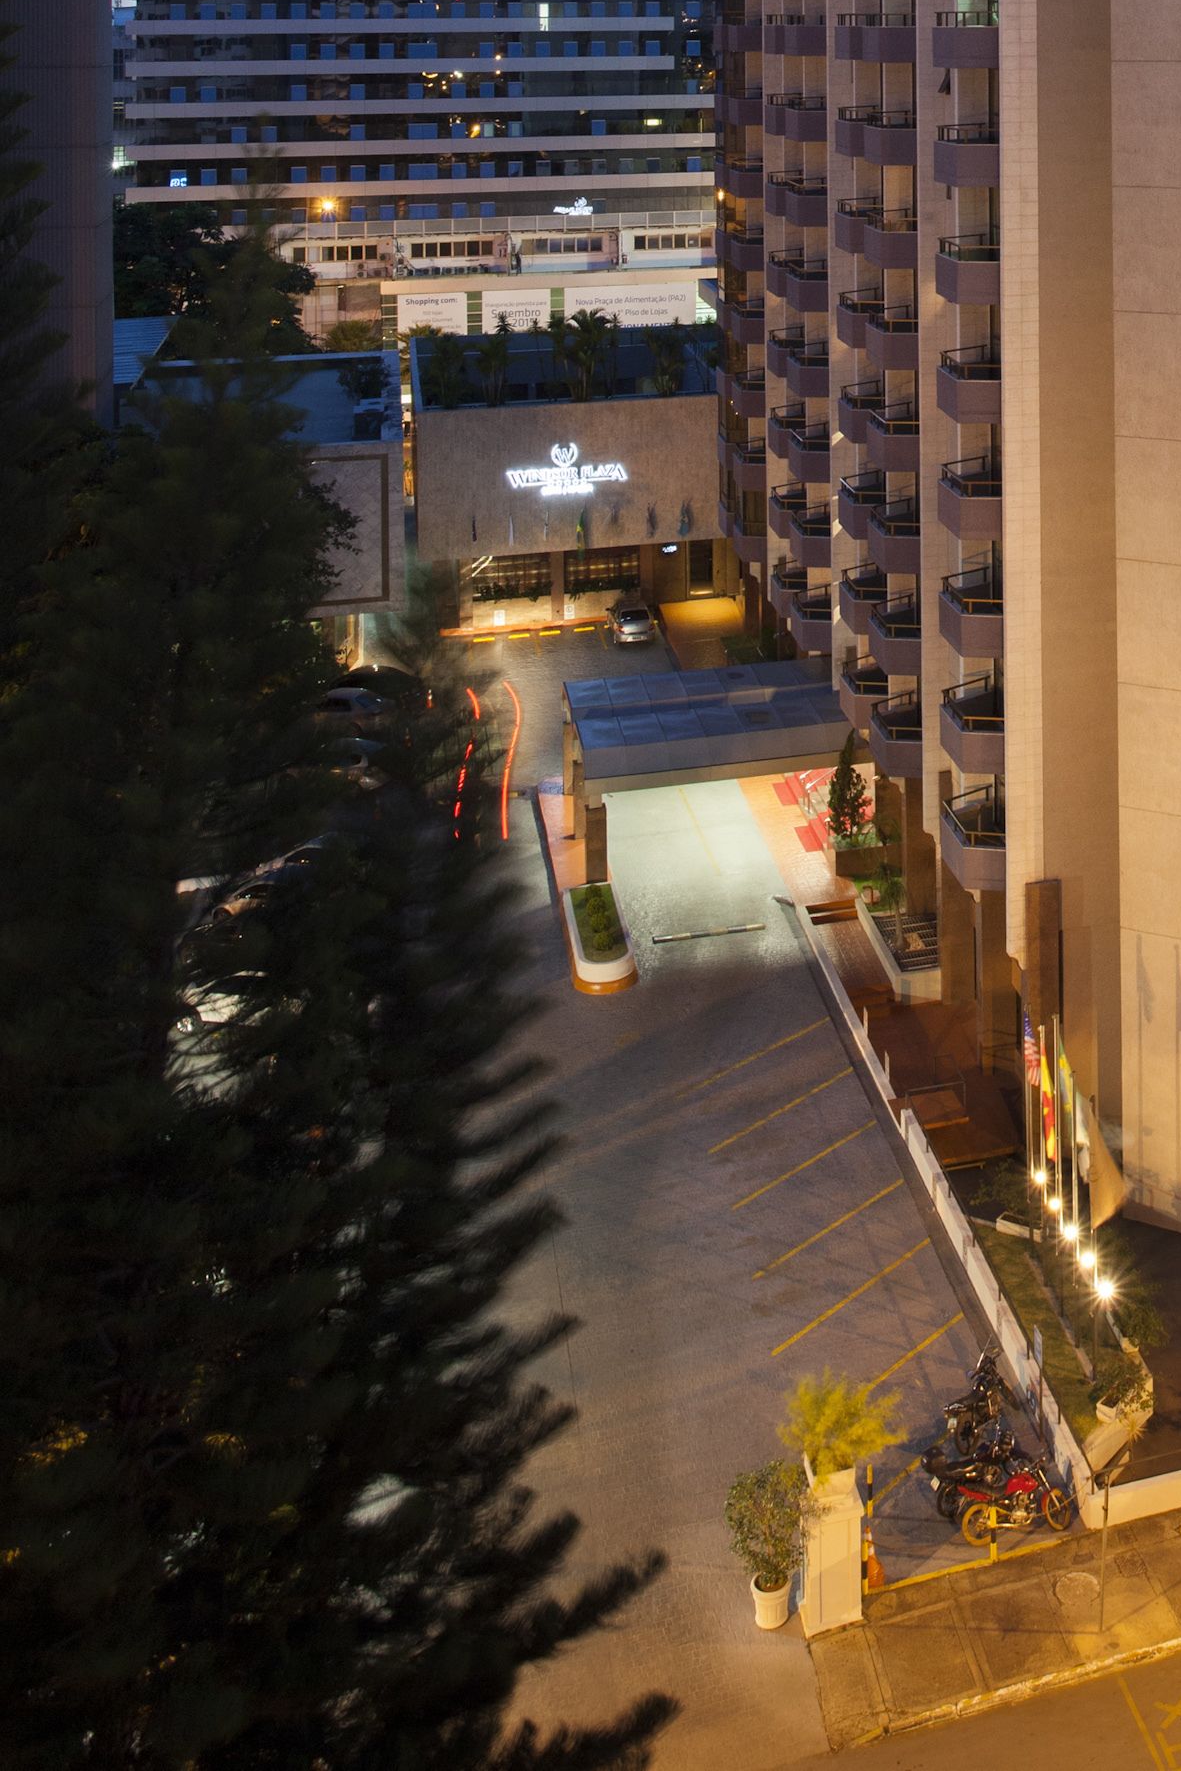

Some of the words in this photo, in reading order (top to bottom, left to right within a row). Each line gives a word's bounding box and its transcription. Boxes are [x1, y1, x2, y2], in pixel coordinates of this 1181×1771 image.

[405, 297, 439, 306] Shopping
[575, 298, 593, 306] Nova
[594, 297, 614, 306] Praça
[614, 296, 623, 304] de
[624, 294, 667, 304] Alimentação
[491, 308, 542, 319] Setembro
[625, 308, 640, 316] Piso
[640, 308, 649, 316] de
[650, 307, 668, 317] Lojas
[505, 466, 579, 488] WINDSOR
[580, 463, 628, 482] PLAZA
